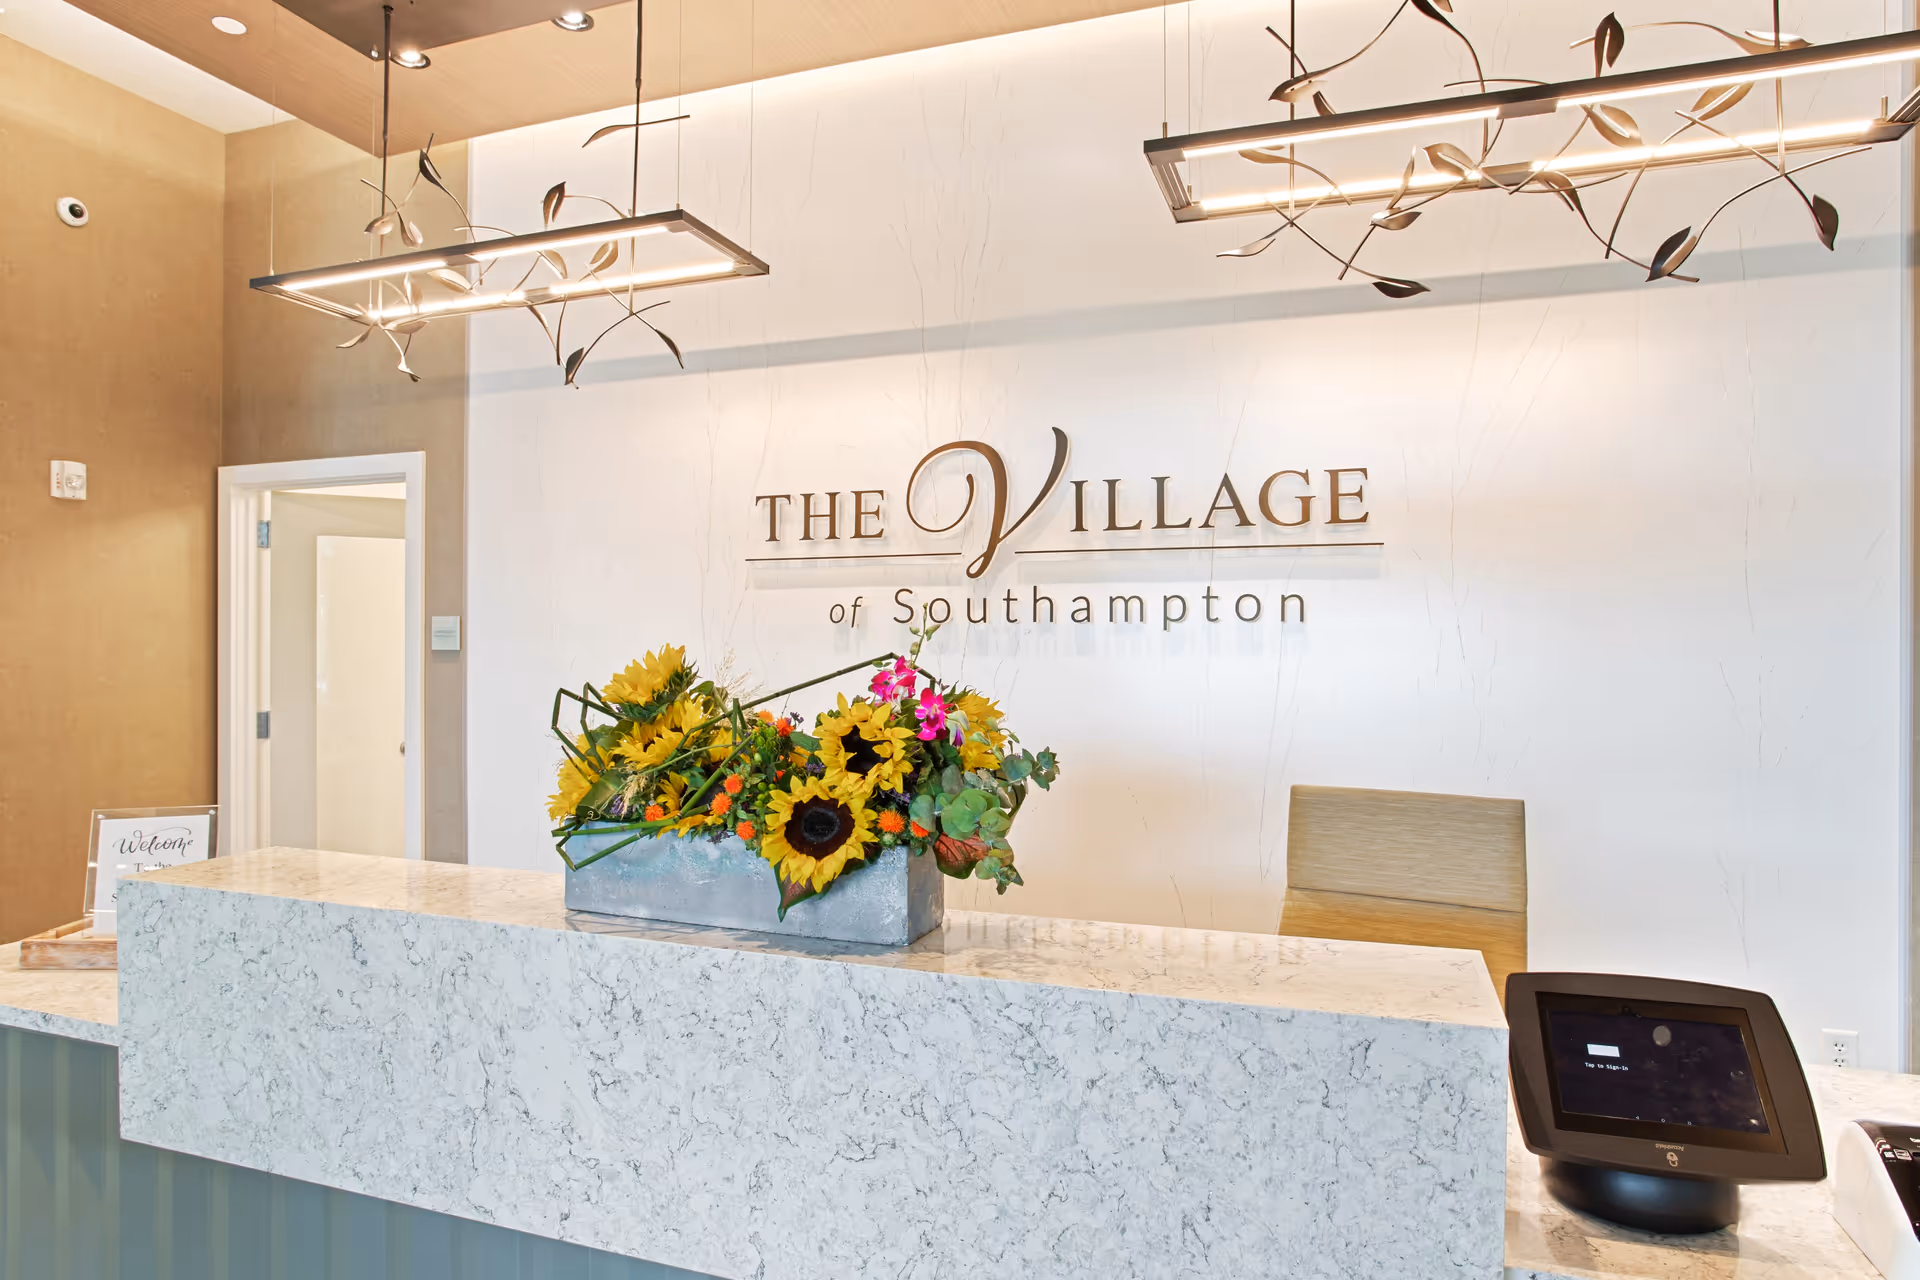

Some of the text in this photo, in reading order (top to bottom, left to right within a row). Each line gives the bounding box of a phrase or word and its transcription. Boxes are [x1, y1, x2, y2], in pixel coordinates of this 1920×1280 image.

[756, 426, 1370, 579] THE VILLAGE
[829, 585, 1307, 631] of Southampton
[113, 827, 194, 857] Welcome
